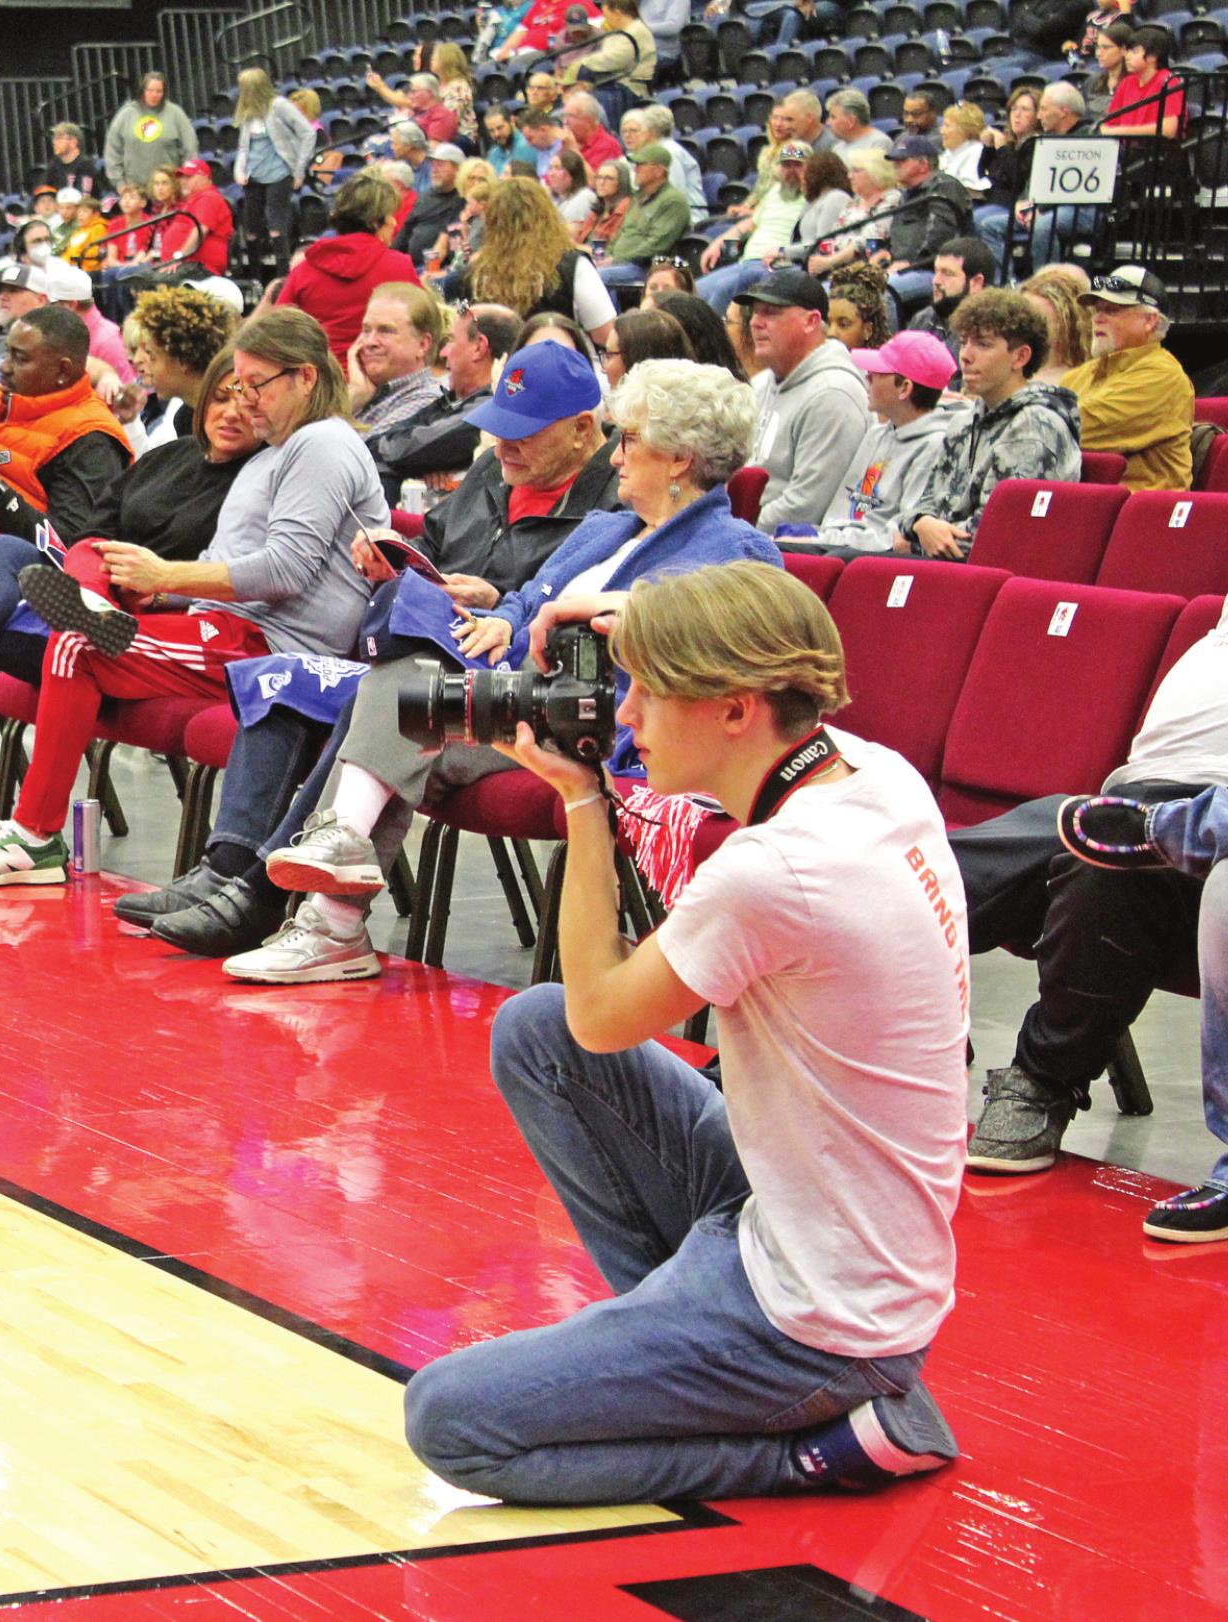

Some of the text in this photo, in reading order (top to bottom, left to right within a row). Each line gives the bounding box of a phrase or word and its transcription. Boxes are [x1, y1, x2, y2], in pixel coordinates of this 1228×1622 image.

[1055, 150, 1102, 161] SECTION
[1049, 166, 1100, 193] 106
[780, 741, 828, 781] Canon
[904, 846, 957, 948] BRING
